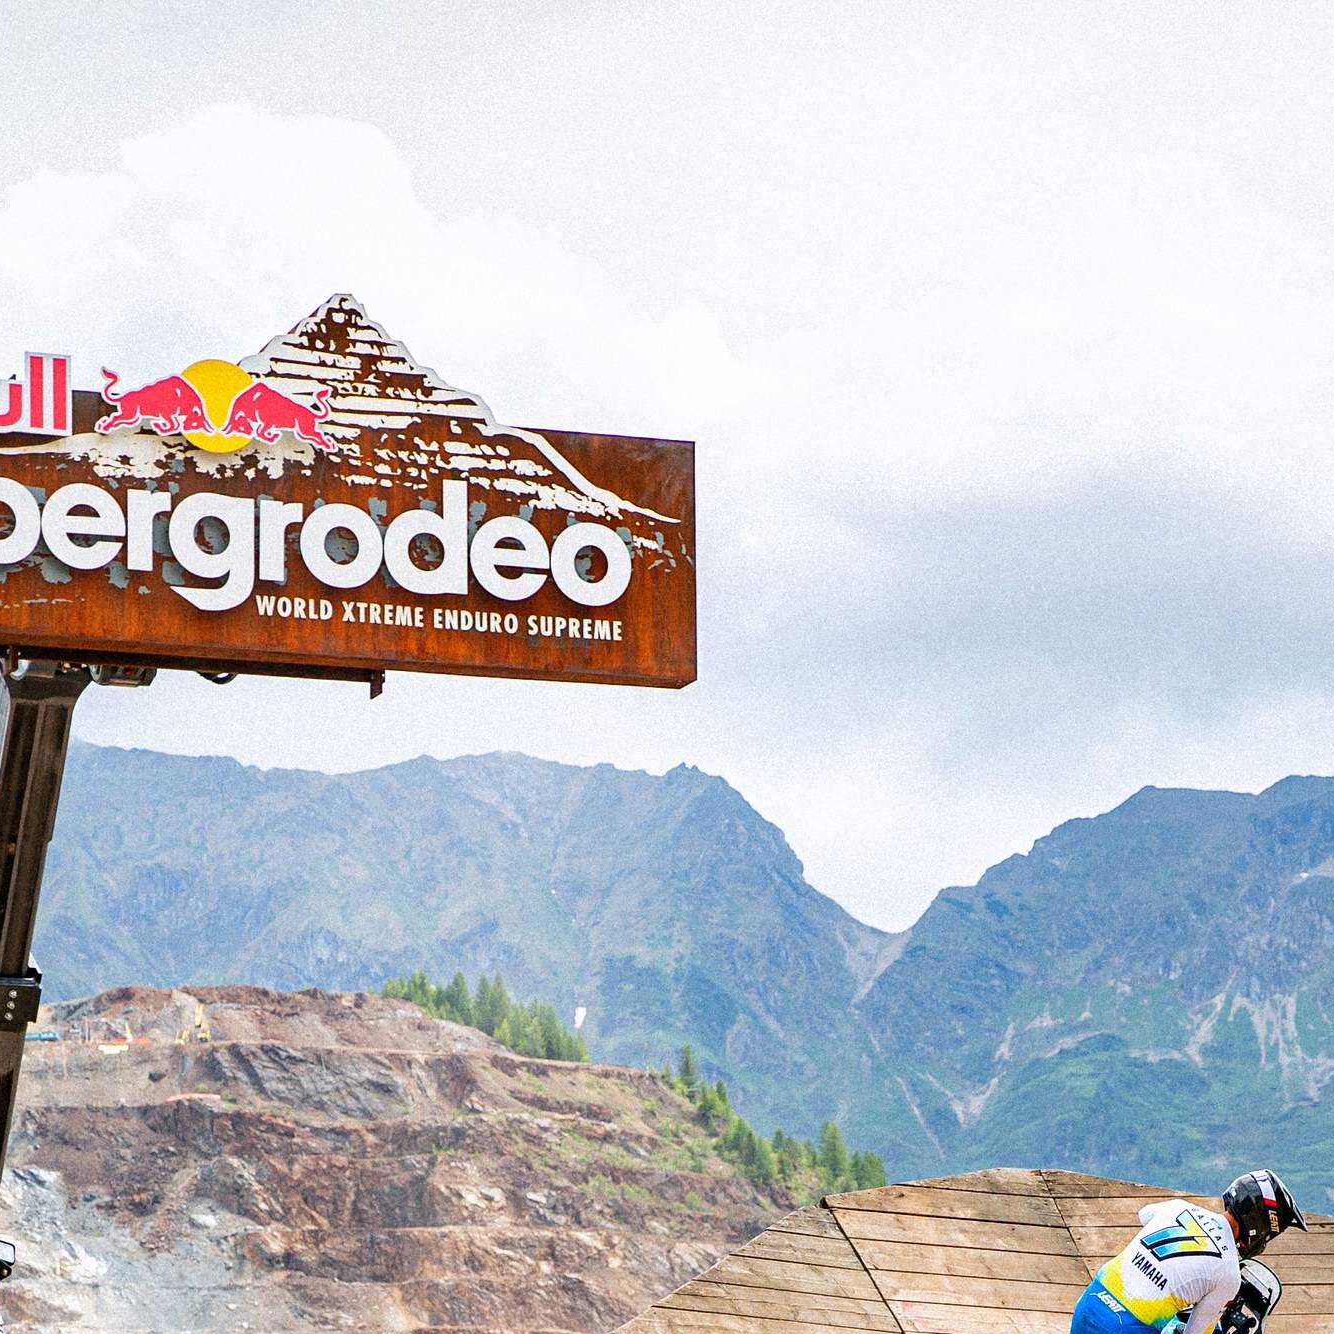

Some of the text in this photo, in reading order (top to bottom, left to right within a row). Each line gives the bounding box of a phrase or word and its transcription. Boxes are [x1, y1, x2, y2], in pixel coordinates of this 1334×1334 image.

[255, 595, 623, 641] WORLD XTREME ENDURO SUPREME
[1131, 1252, 1169, 1291] YAMAHA
